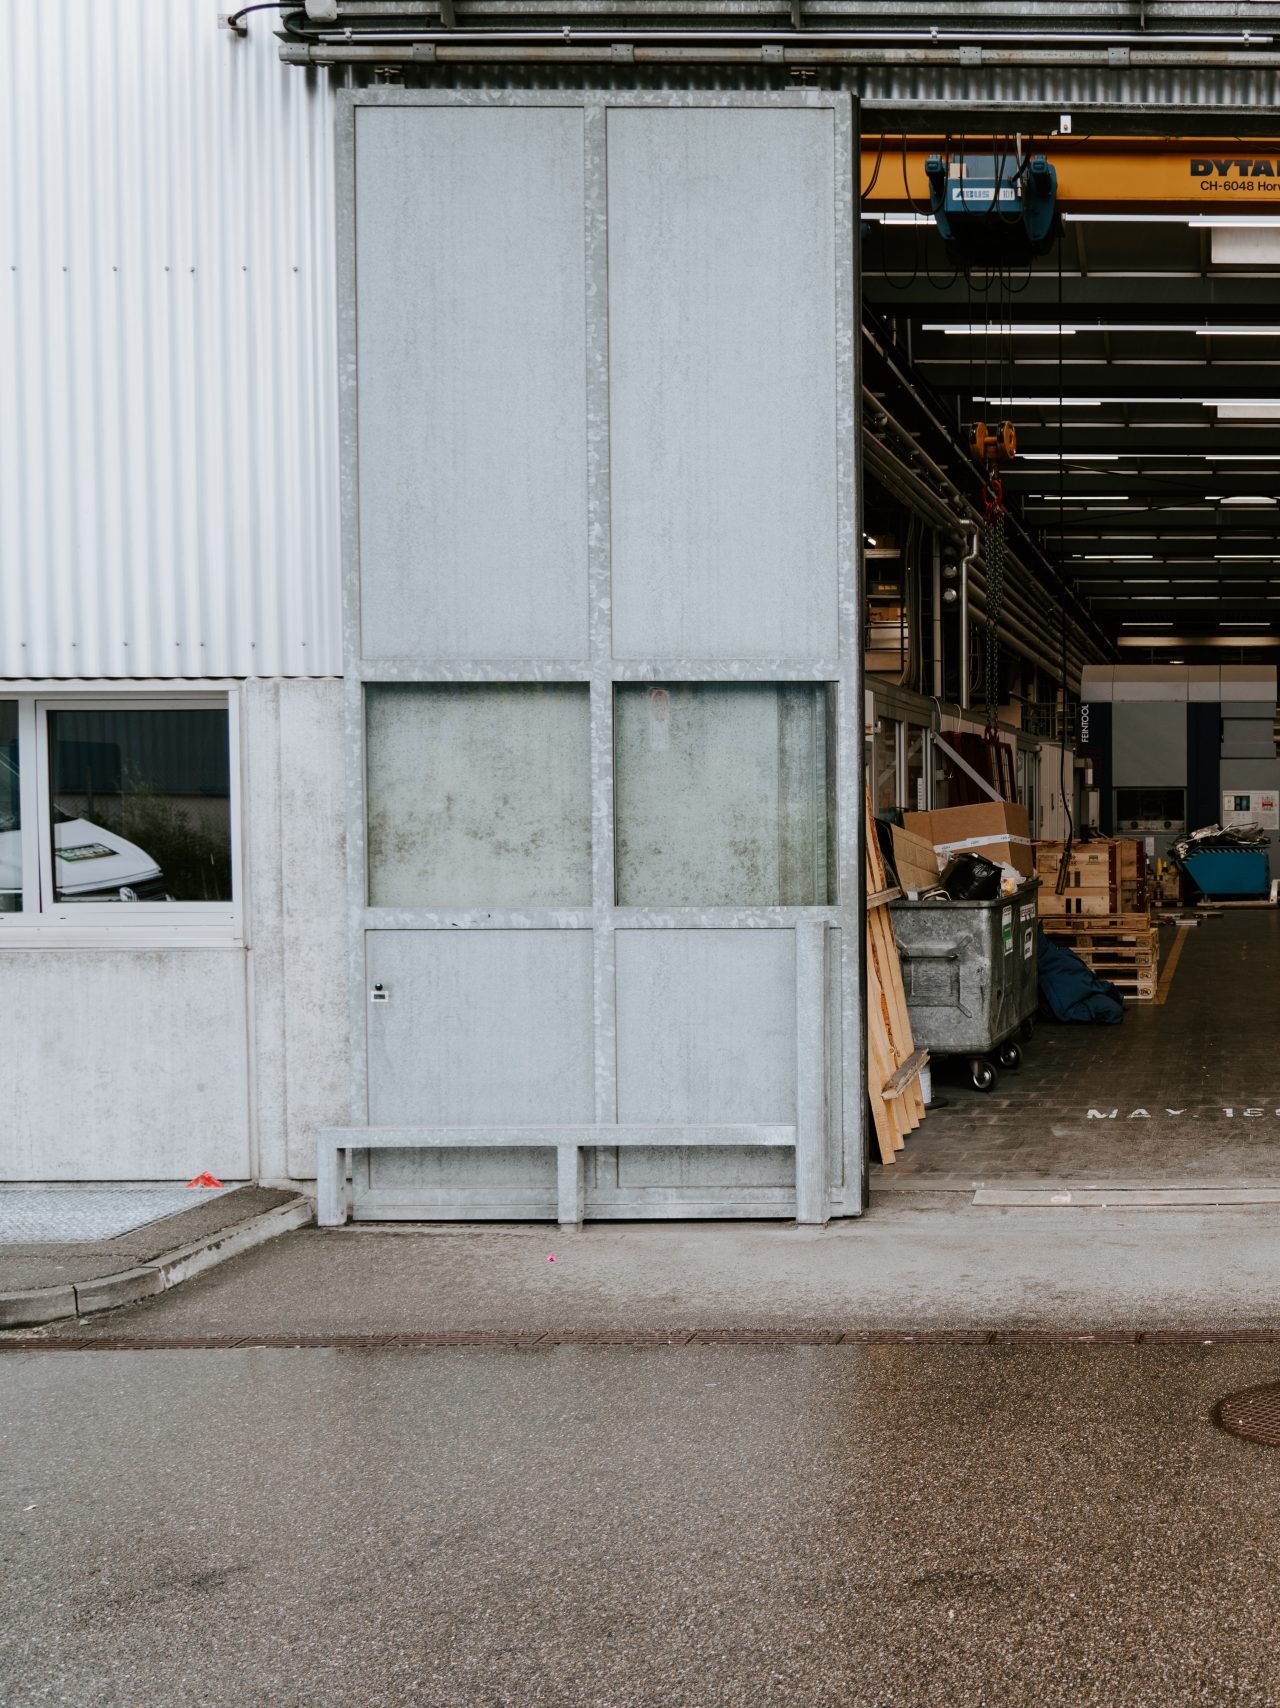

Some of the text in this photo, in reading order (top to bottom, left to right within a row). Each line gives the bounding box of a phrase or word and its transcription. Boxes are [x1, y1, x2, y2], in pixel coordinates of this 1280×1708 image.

[1200, 181, 1255, 191] CH-6048
[955, 190, 990, 199] ABUS
[1081, 703, 1089, 743] FEINTOOL
